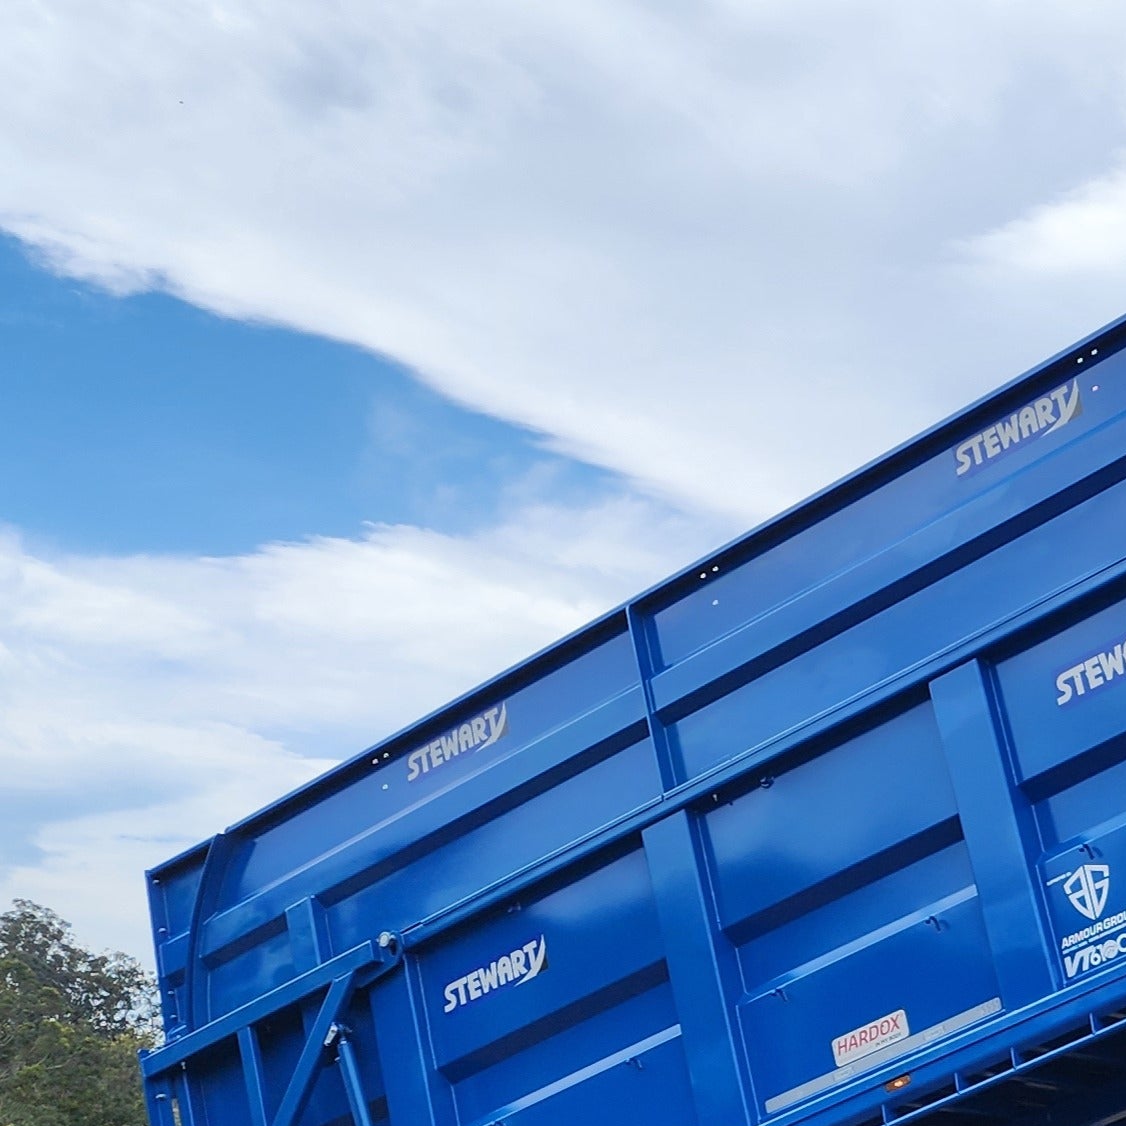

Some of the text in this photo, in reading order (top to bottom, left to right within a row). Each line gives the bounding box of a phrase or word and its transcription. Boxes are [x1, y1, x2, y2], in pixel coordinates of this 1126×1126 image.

[956, 378, 1080, 476] STEWART
[407, 701, 508, 782] STEWART
[444, 934, 547, 1013] STEWART
[837, 1014, 901, 1057] HARDOX
